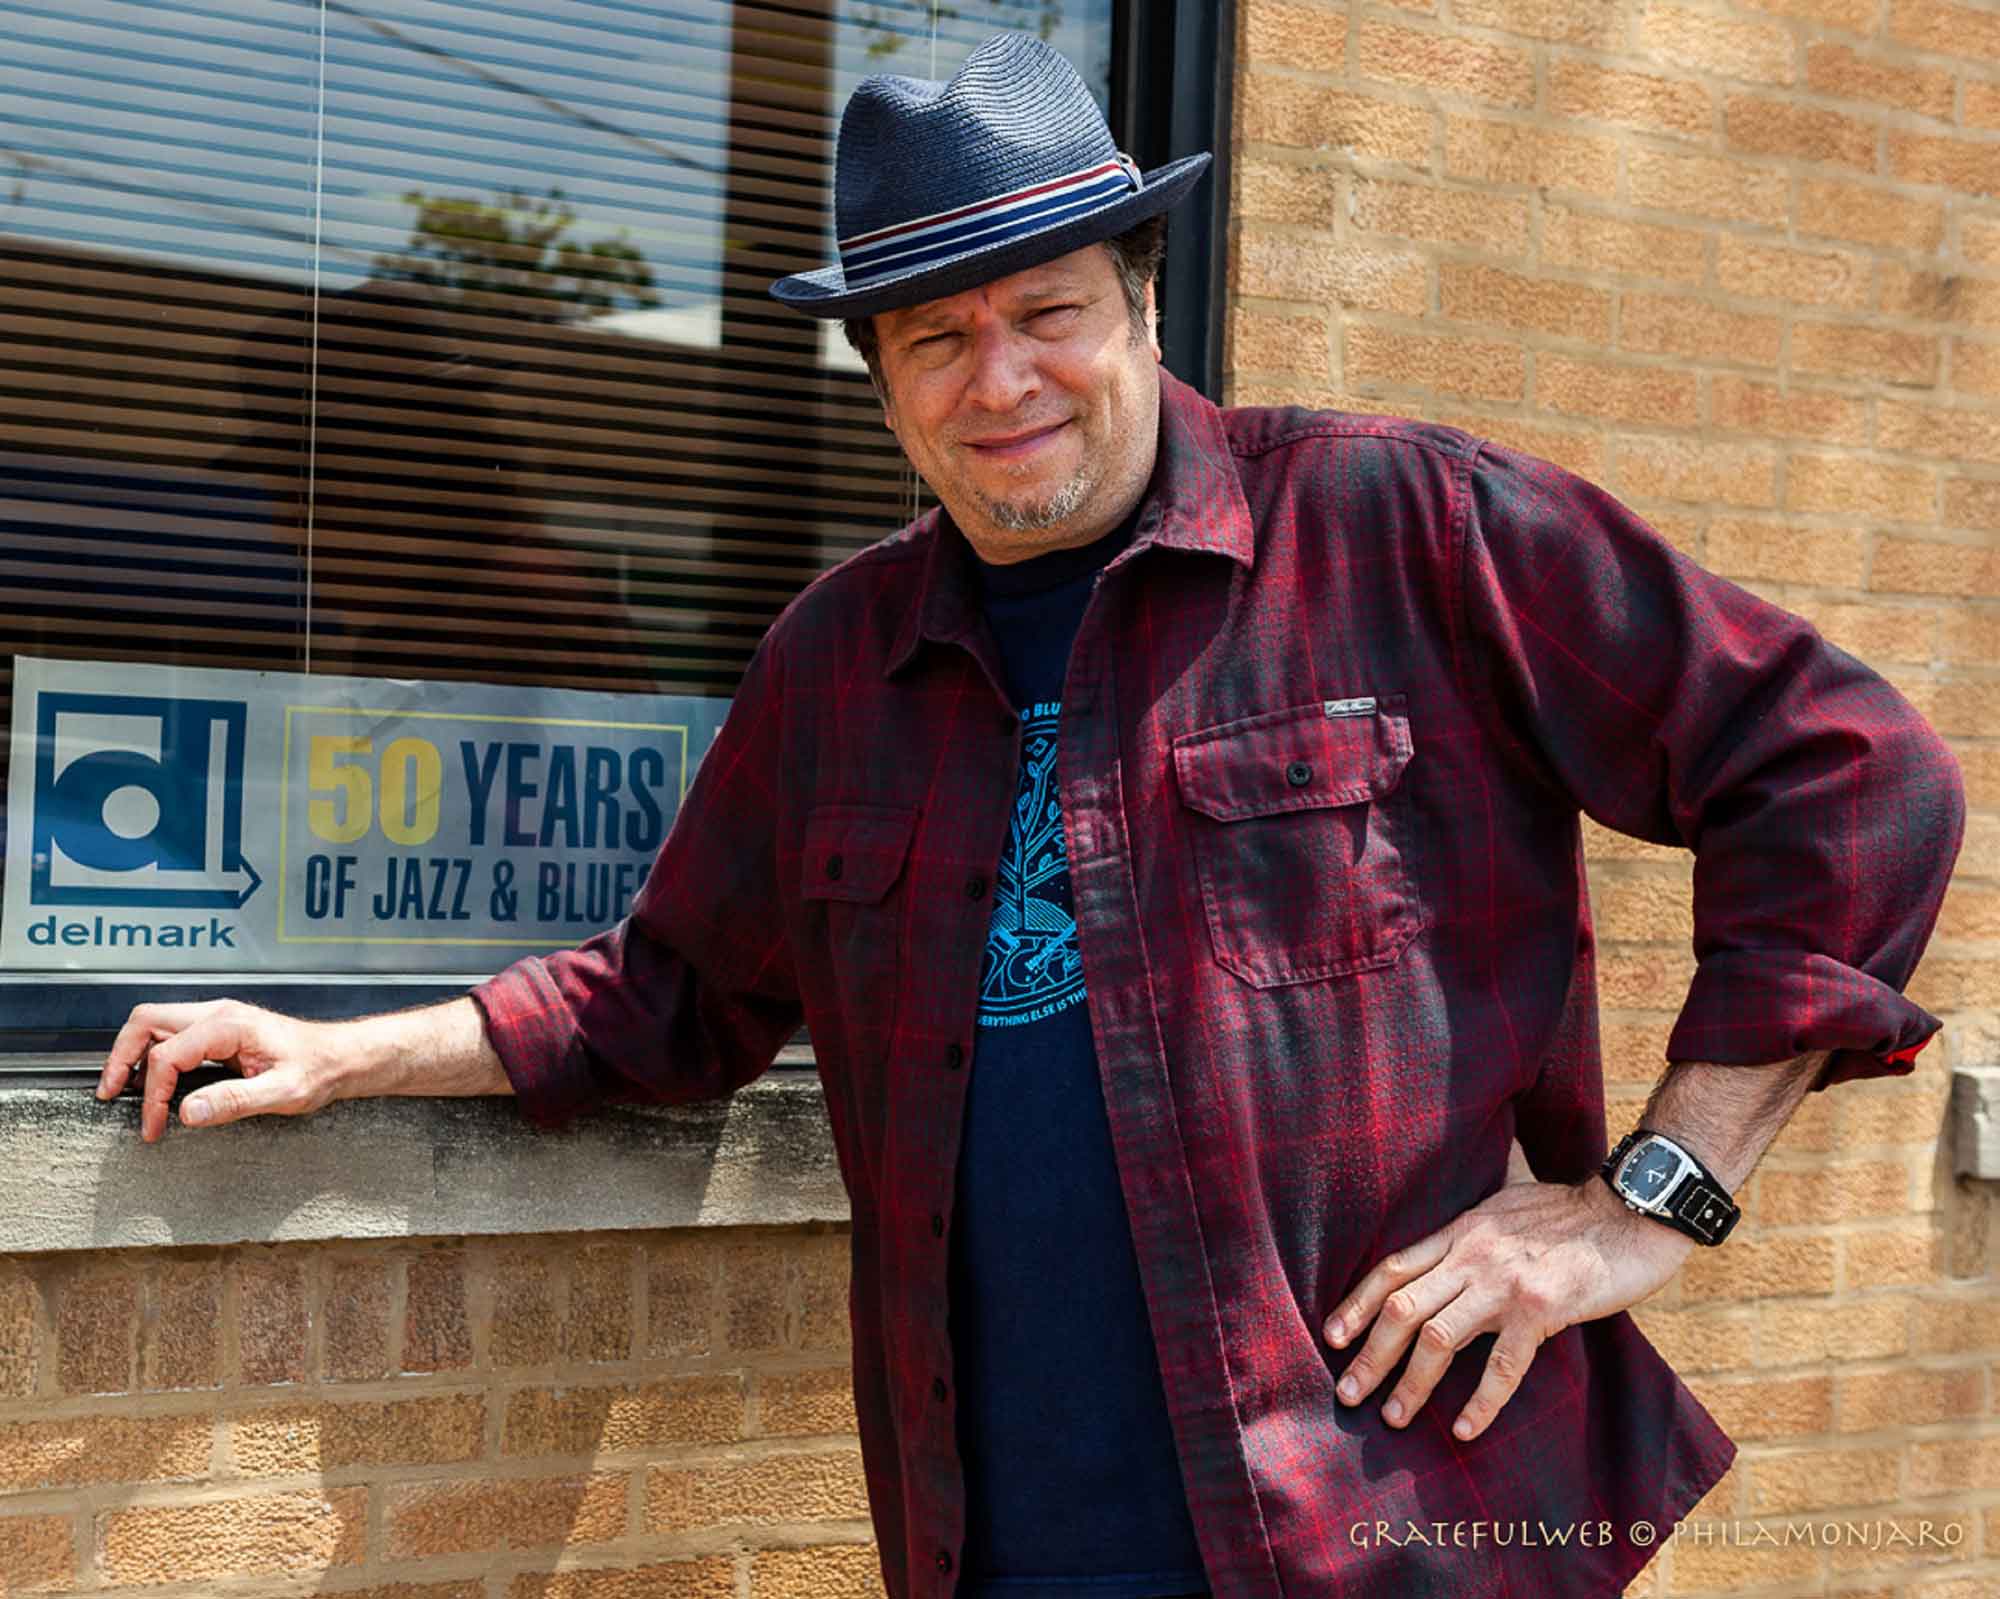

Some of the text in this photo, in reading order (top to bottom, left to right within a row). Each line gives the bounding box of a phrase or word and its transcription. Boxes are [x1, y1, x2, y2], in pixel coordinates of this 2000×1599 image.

[308, 735, 667, 850] 50 YEARS
[305, 853, 357, 919] OF
[372, 856, 472, 921] JAZZ
[490, 860, 519, 922] &
[27, 915, 236, 948] delmark
